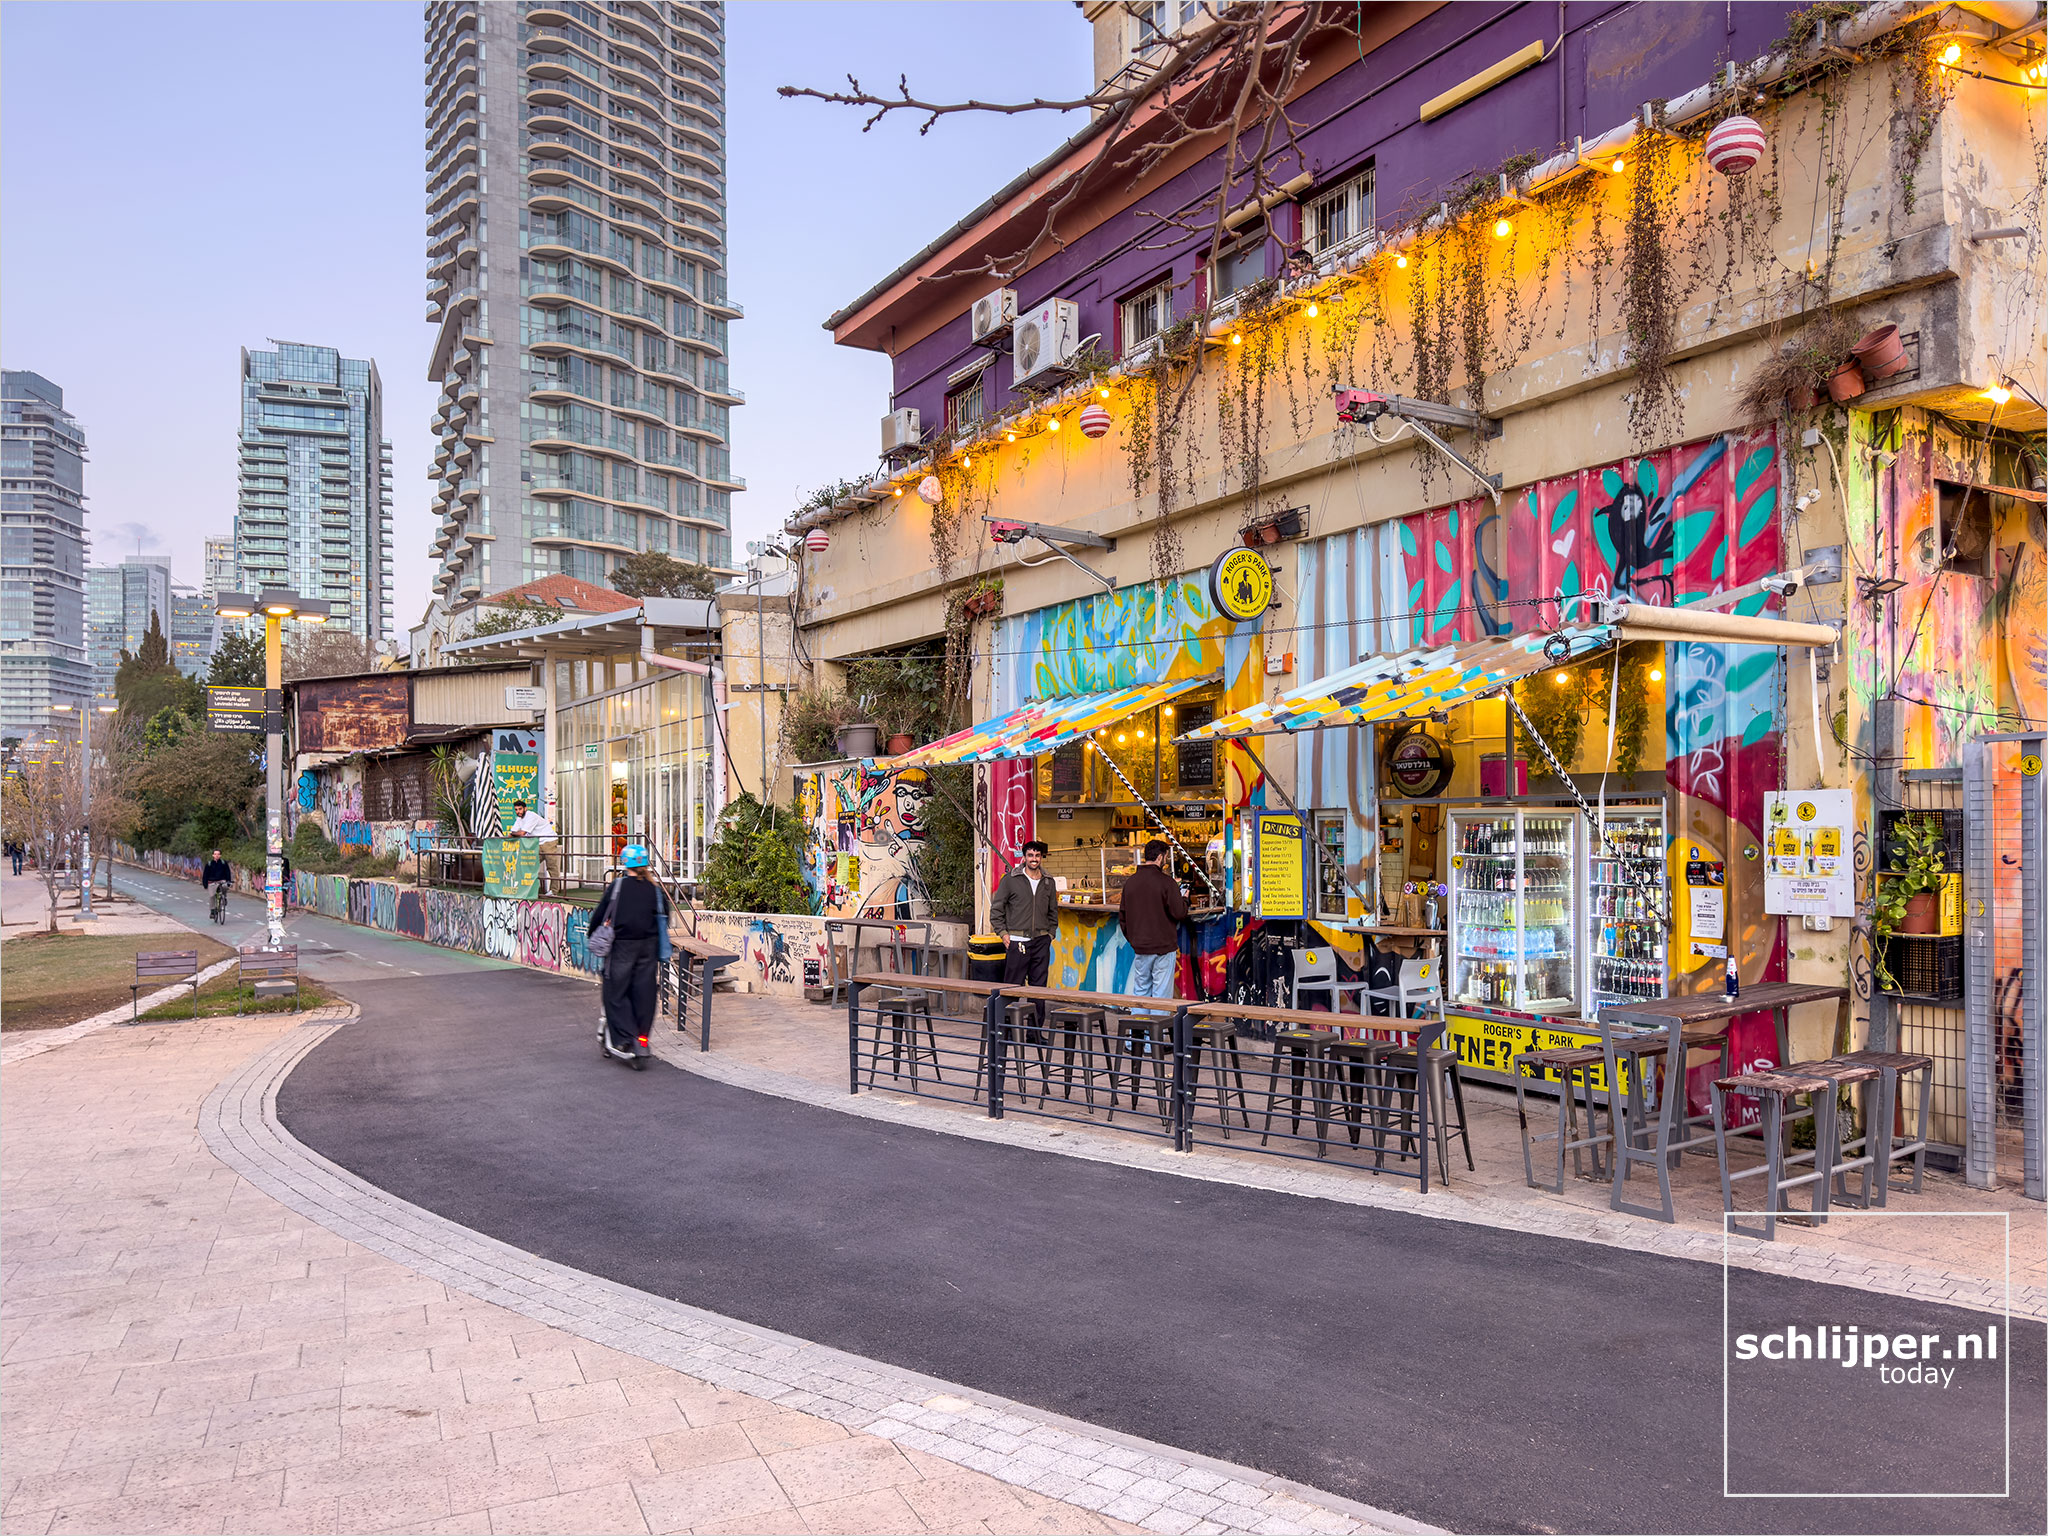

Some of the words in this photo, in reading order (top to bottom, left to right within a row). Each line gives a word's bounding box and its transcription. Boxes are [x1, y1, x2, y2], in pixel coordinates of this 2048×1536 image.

[1226, 554, 1252, 574] ROGER'S
[1252, 557, 1268, 578] PARK
[496, 765, 538, 774] SLHUSH
[1264, 822, 1299, 837] DRINKS
[1484, 1024, 1522, 1040] ROGER'S
[1549, 1034, 1574, 1048] PARK
[1440, 1032, 1512, 1070] INE?
